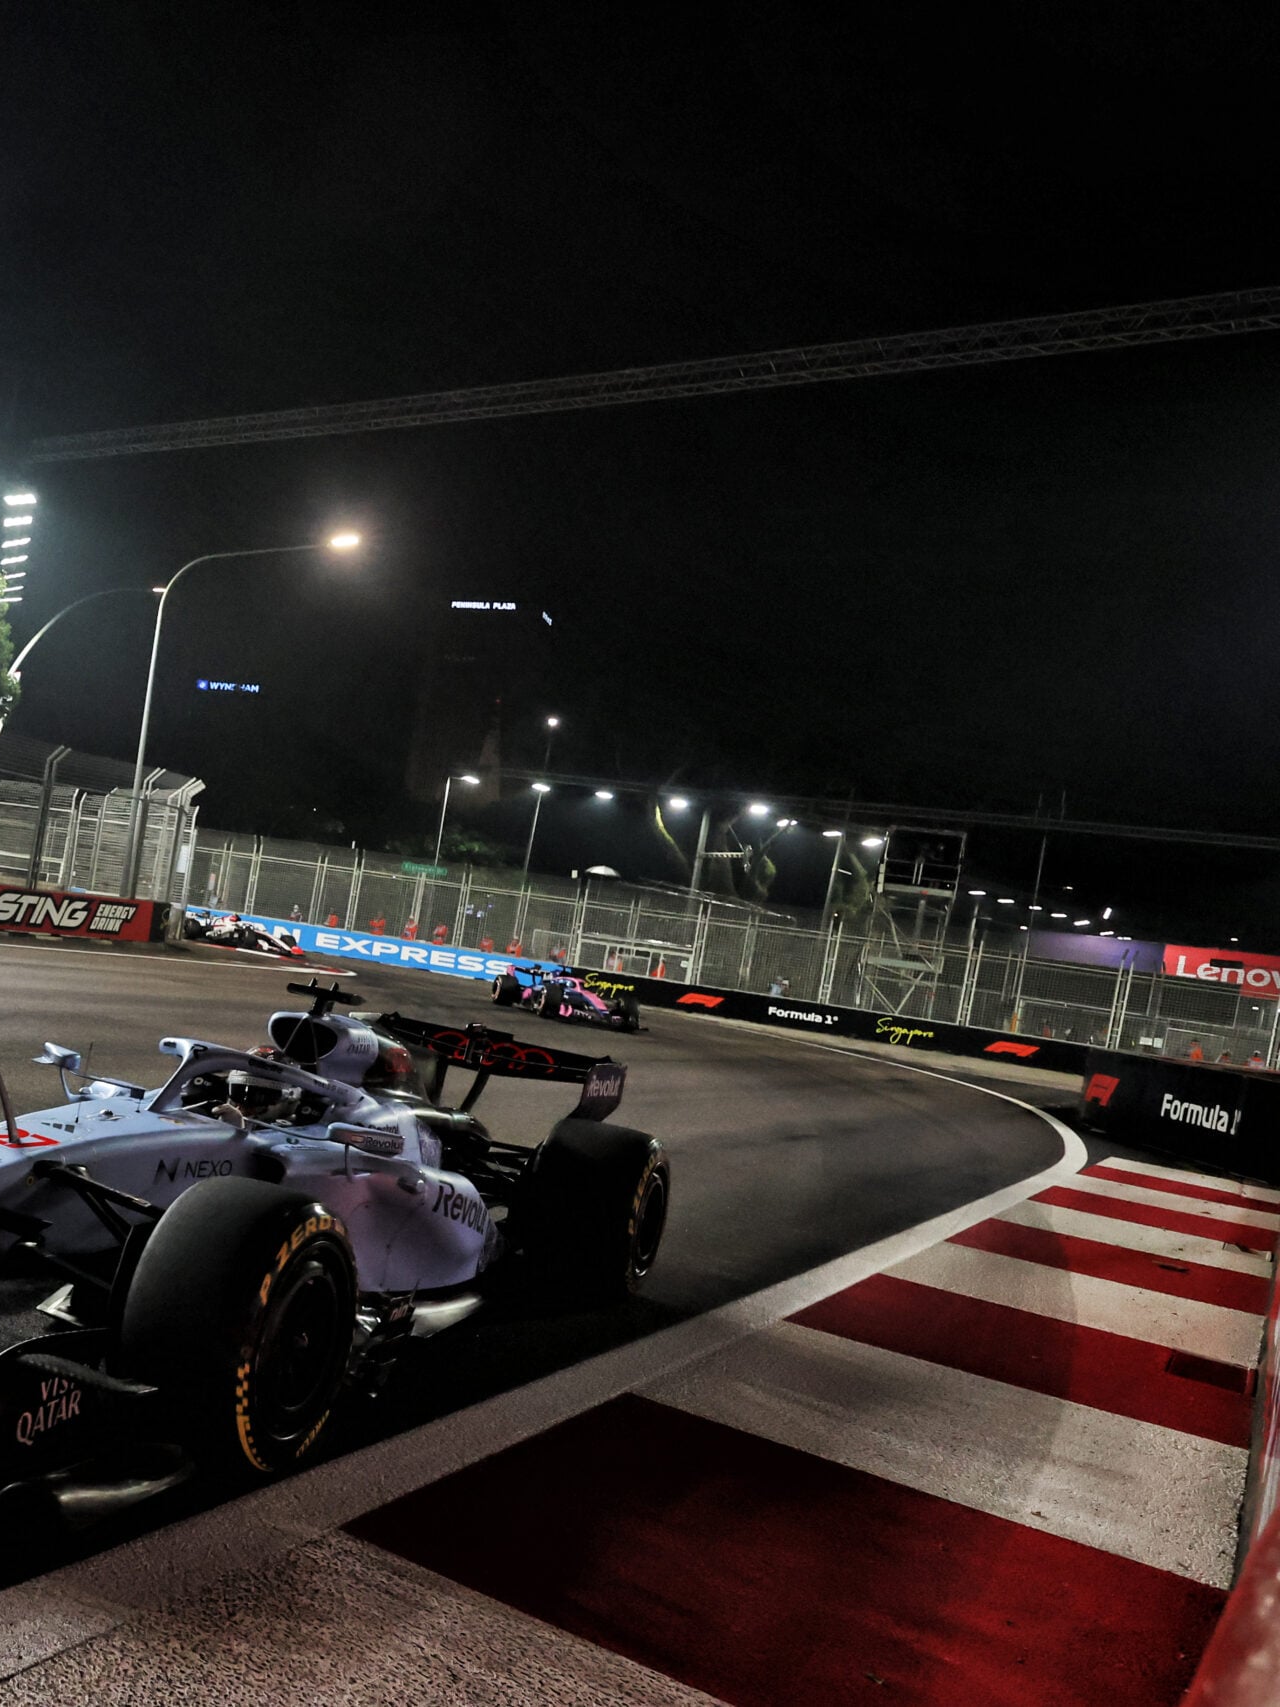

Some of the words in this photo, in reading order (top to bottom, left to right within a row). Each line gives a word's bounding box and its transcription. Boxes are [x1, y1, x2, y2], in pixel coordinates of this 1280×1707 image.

[493, 602, 516, 610] PLAZA
[95, 903, 137, 921] ENERGY
[89, 916, 121, 933] DRINK
[315, 932, 508, 976] EXPRESS
[768, 1006, 823, 1023] Formula
[875, 1017, 935, 1044] Singapore
[1160, 1093, 1229, 1133] Formula
[184, 1159, 233, 1178] NEXO
[275, 1214, 333, 1272] ZERO
[16, 1389, 81, 1447] QATAR
